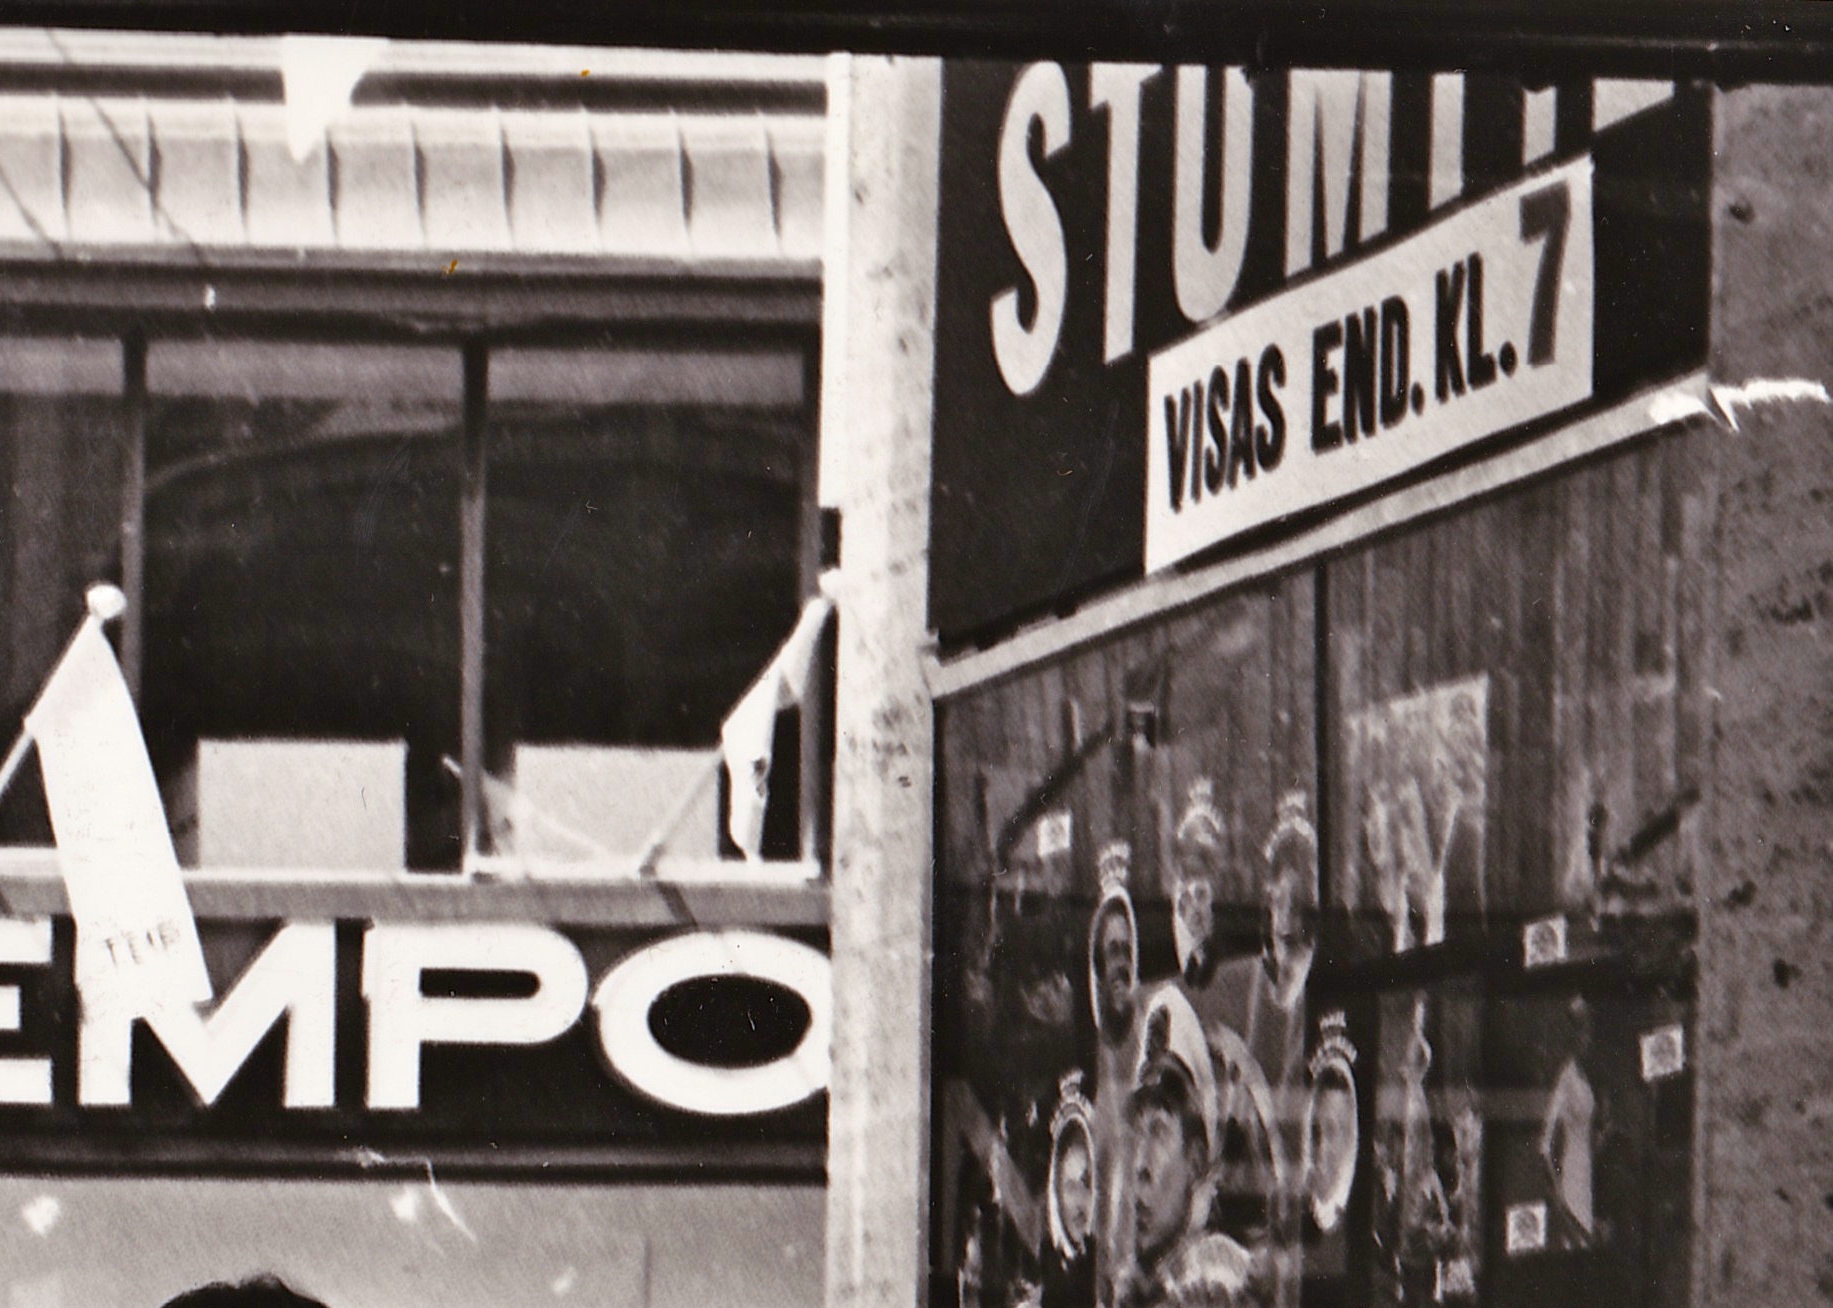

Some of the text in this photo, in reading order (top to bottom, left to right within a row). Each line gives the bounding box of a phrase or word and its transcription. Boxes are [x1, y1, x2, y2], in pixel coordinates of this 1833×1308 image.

[1164, 180, 1573, 514] VISAS END. KL. 7
